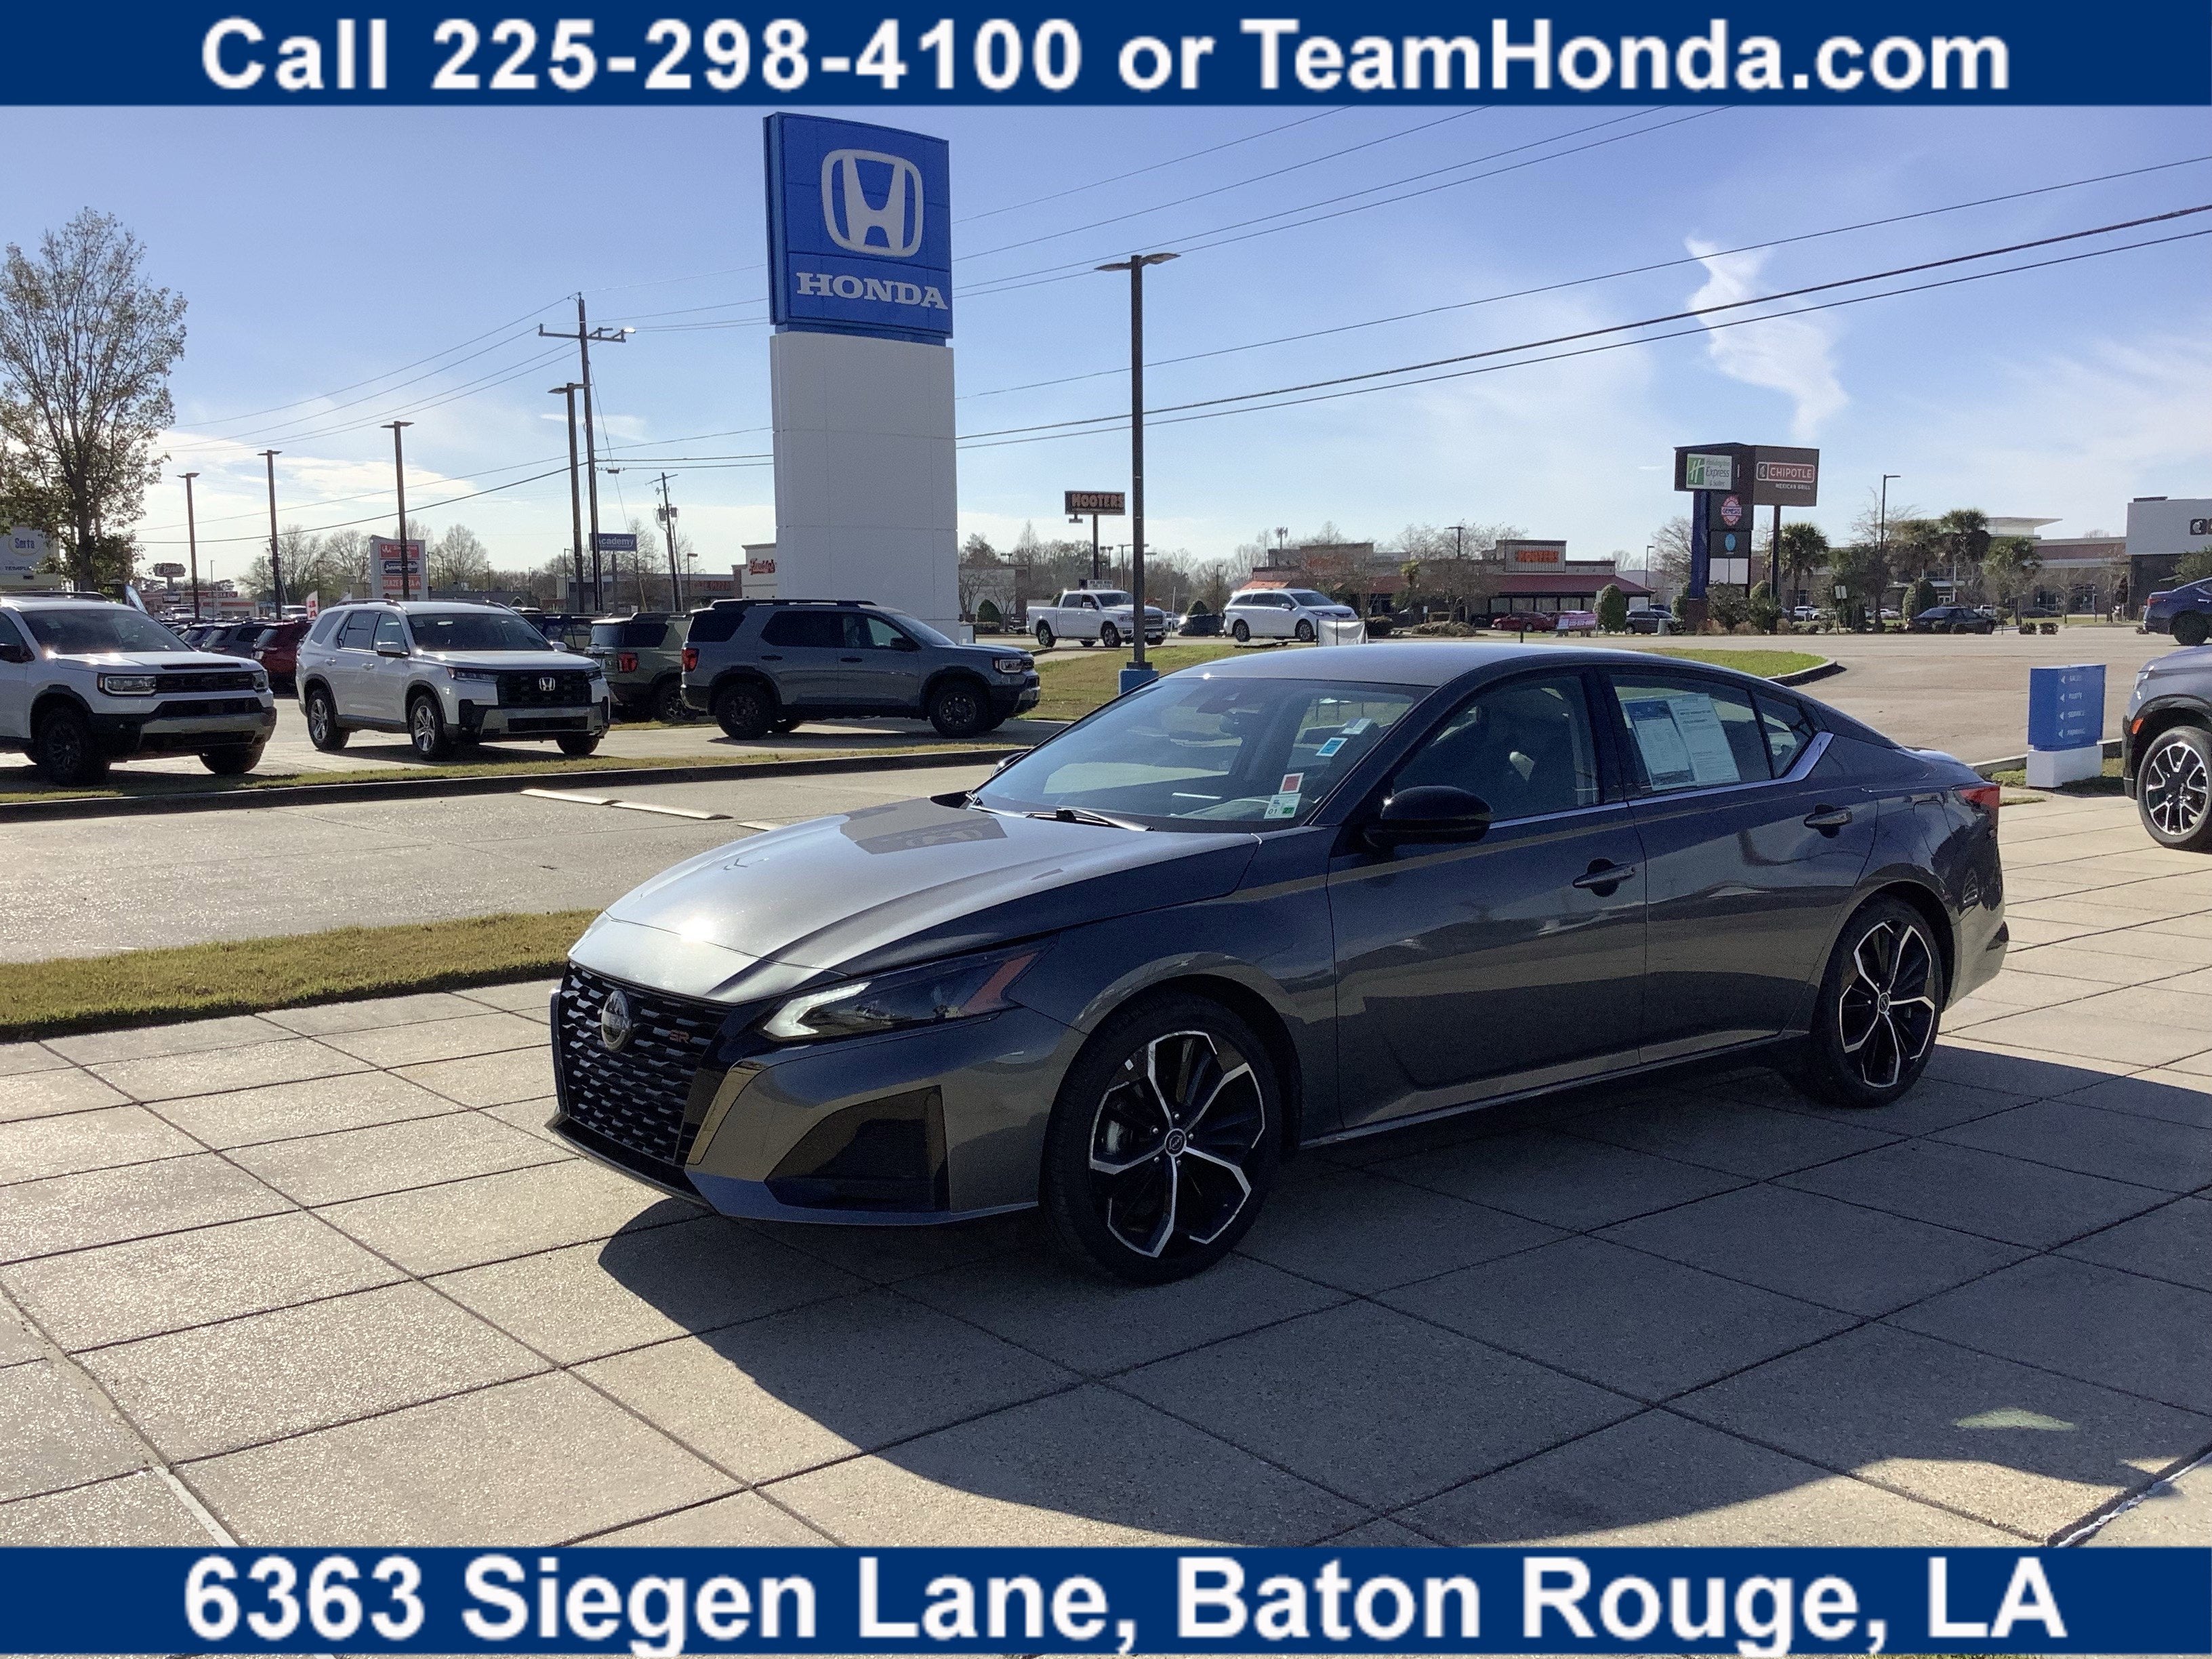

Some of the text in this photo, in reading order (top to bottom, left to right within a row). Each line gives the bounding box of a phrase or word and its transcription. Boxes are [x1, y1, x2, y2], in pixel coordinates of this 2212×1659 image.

[796, 272, 948, 310] HONDA
[1706, 466, 1730, 478] Express
[1769, 467, 1812, 478] CHIPOTLE
[1071, 494, 1124, 508] HOOTERS
[14, 537, 35, 549] Serta
